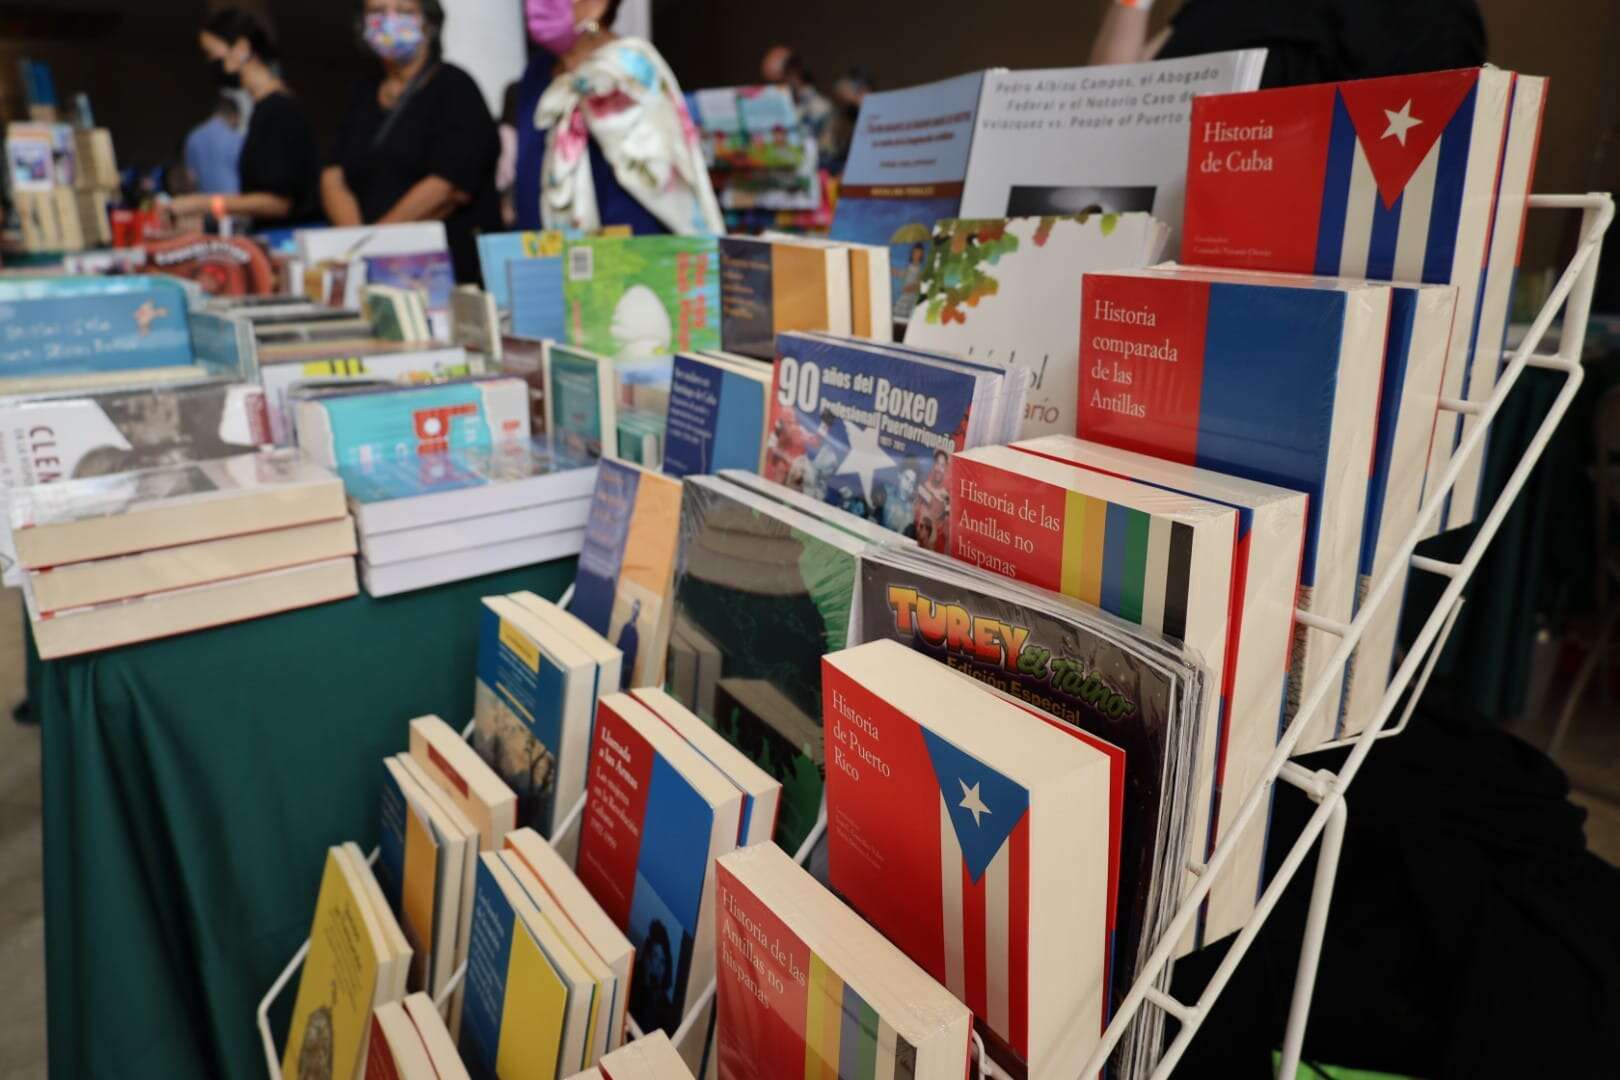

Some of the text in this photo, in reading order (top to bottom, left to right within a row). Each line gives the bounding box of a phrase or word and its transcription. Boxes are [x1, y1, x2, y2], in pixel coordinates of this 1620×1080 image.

[995, 80, 1031, 94] Pedro
[1035, 78, 1075, 92] Albizu
[1140, 73, 1152, 85] el
[1157, 66, 1219, 84] Abogado
[1006, 98, 1056, 112] Federal
[1070, 98, 1081, 110] el
[1086, 95, 1138, 109] Notorio
[1142, 92, 1174, 106] Caso
[1070, 114, 1112, 129] People
[1118, 113, 1131, 127] of
[1136, 111, 1184, 127] Puerto
[1203, 119, 1273, 143] Historia
[1201, 149, 1273, 173] de Cuba
[1094, 299, 1156, 327] Historia
[1092, 335, 1178, 362] comparada
[777, 356, 938, 428] 90 años del Boxeo
[1091, 358, 1132, 385] de las
[1090, 388, 1146, 418] Antillas
[880, 414, 956, 454] Puertorriqueño
[959, 478, 1060, 532] Historia de las
[959, 509, 1034, 554] Antillas no
[958, 535, 1017, 578] hispanas
[887, 584, 1030, 674] TUREY
[946, 655, 1081, 727] Edición Especial
[831, 688, 880, 742] Historia
[832, 719, 891, 778] de Puerto
[834, 746, 860, 782] Rico
[722, 886, 806, 987] Historia de las
[722, 918, 784, 995] Antillas no
[721, 941, 770, 1010] hispanas
